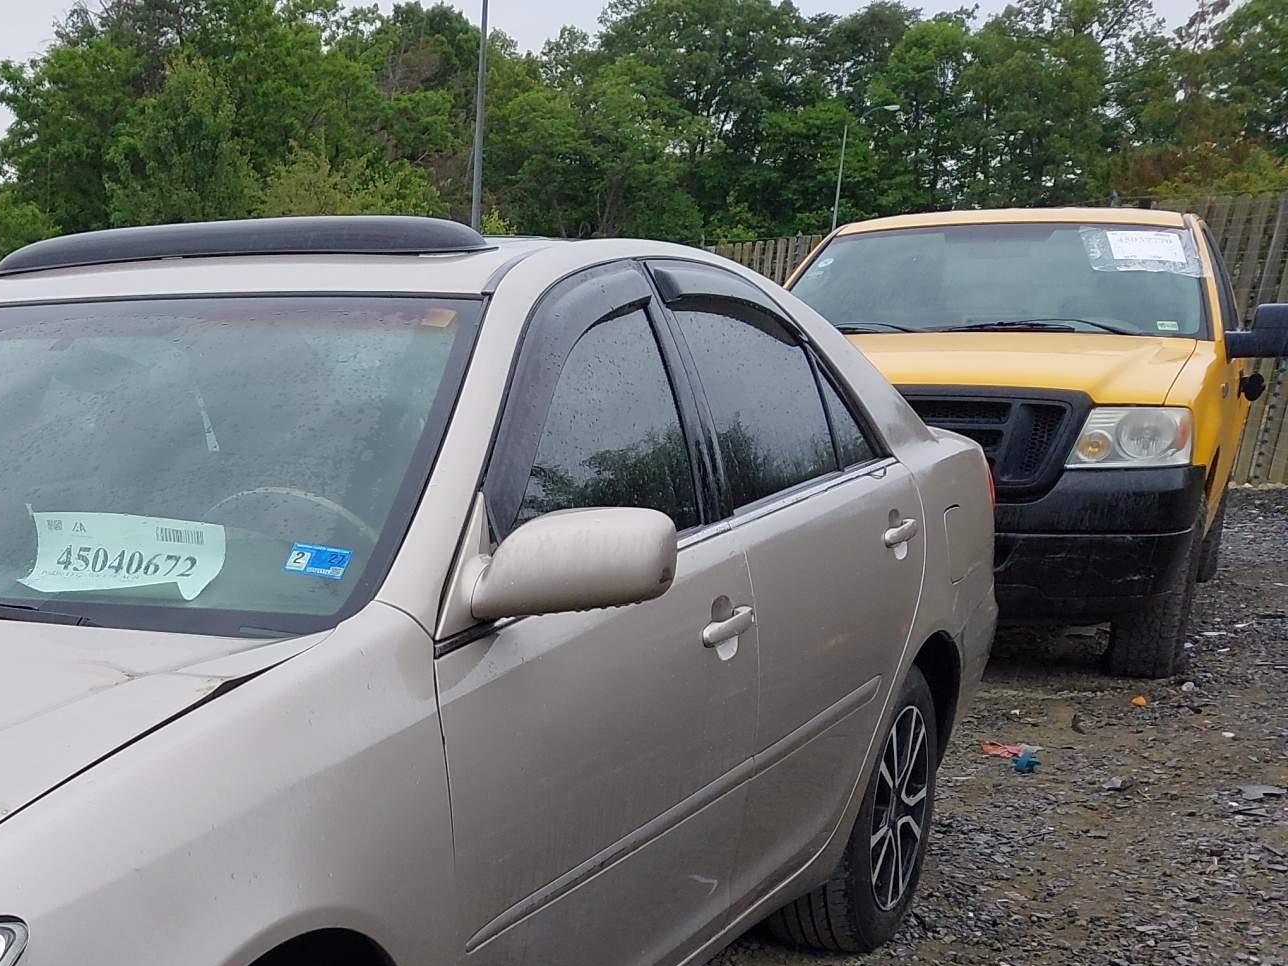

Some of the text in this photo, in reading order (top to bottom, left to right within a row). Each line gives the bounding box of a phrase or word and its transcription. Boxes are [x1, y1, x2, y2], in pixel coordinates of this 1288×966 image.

[56, 544, 198, 578] 45040672
[292, 551, 346, 565] 2 27
